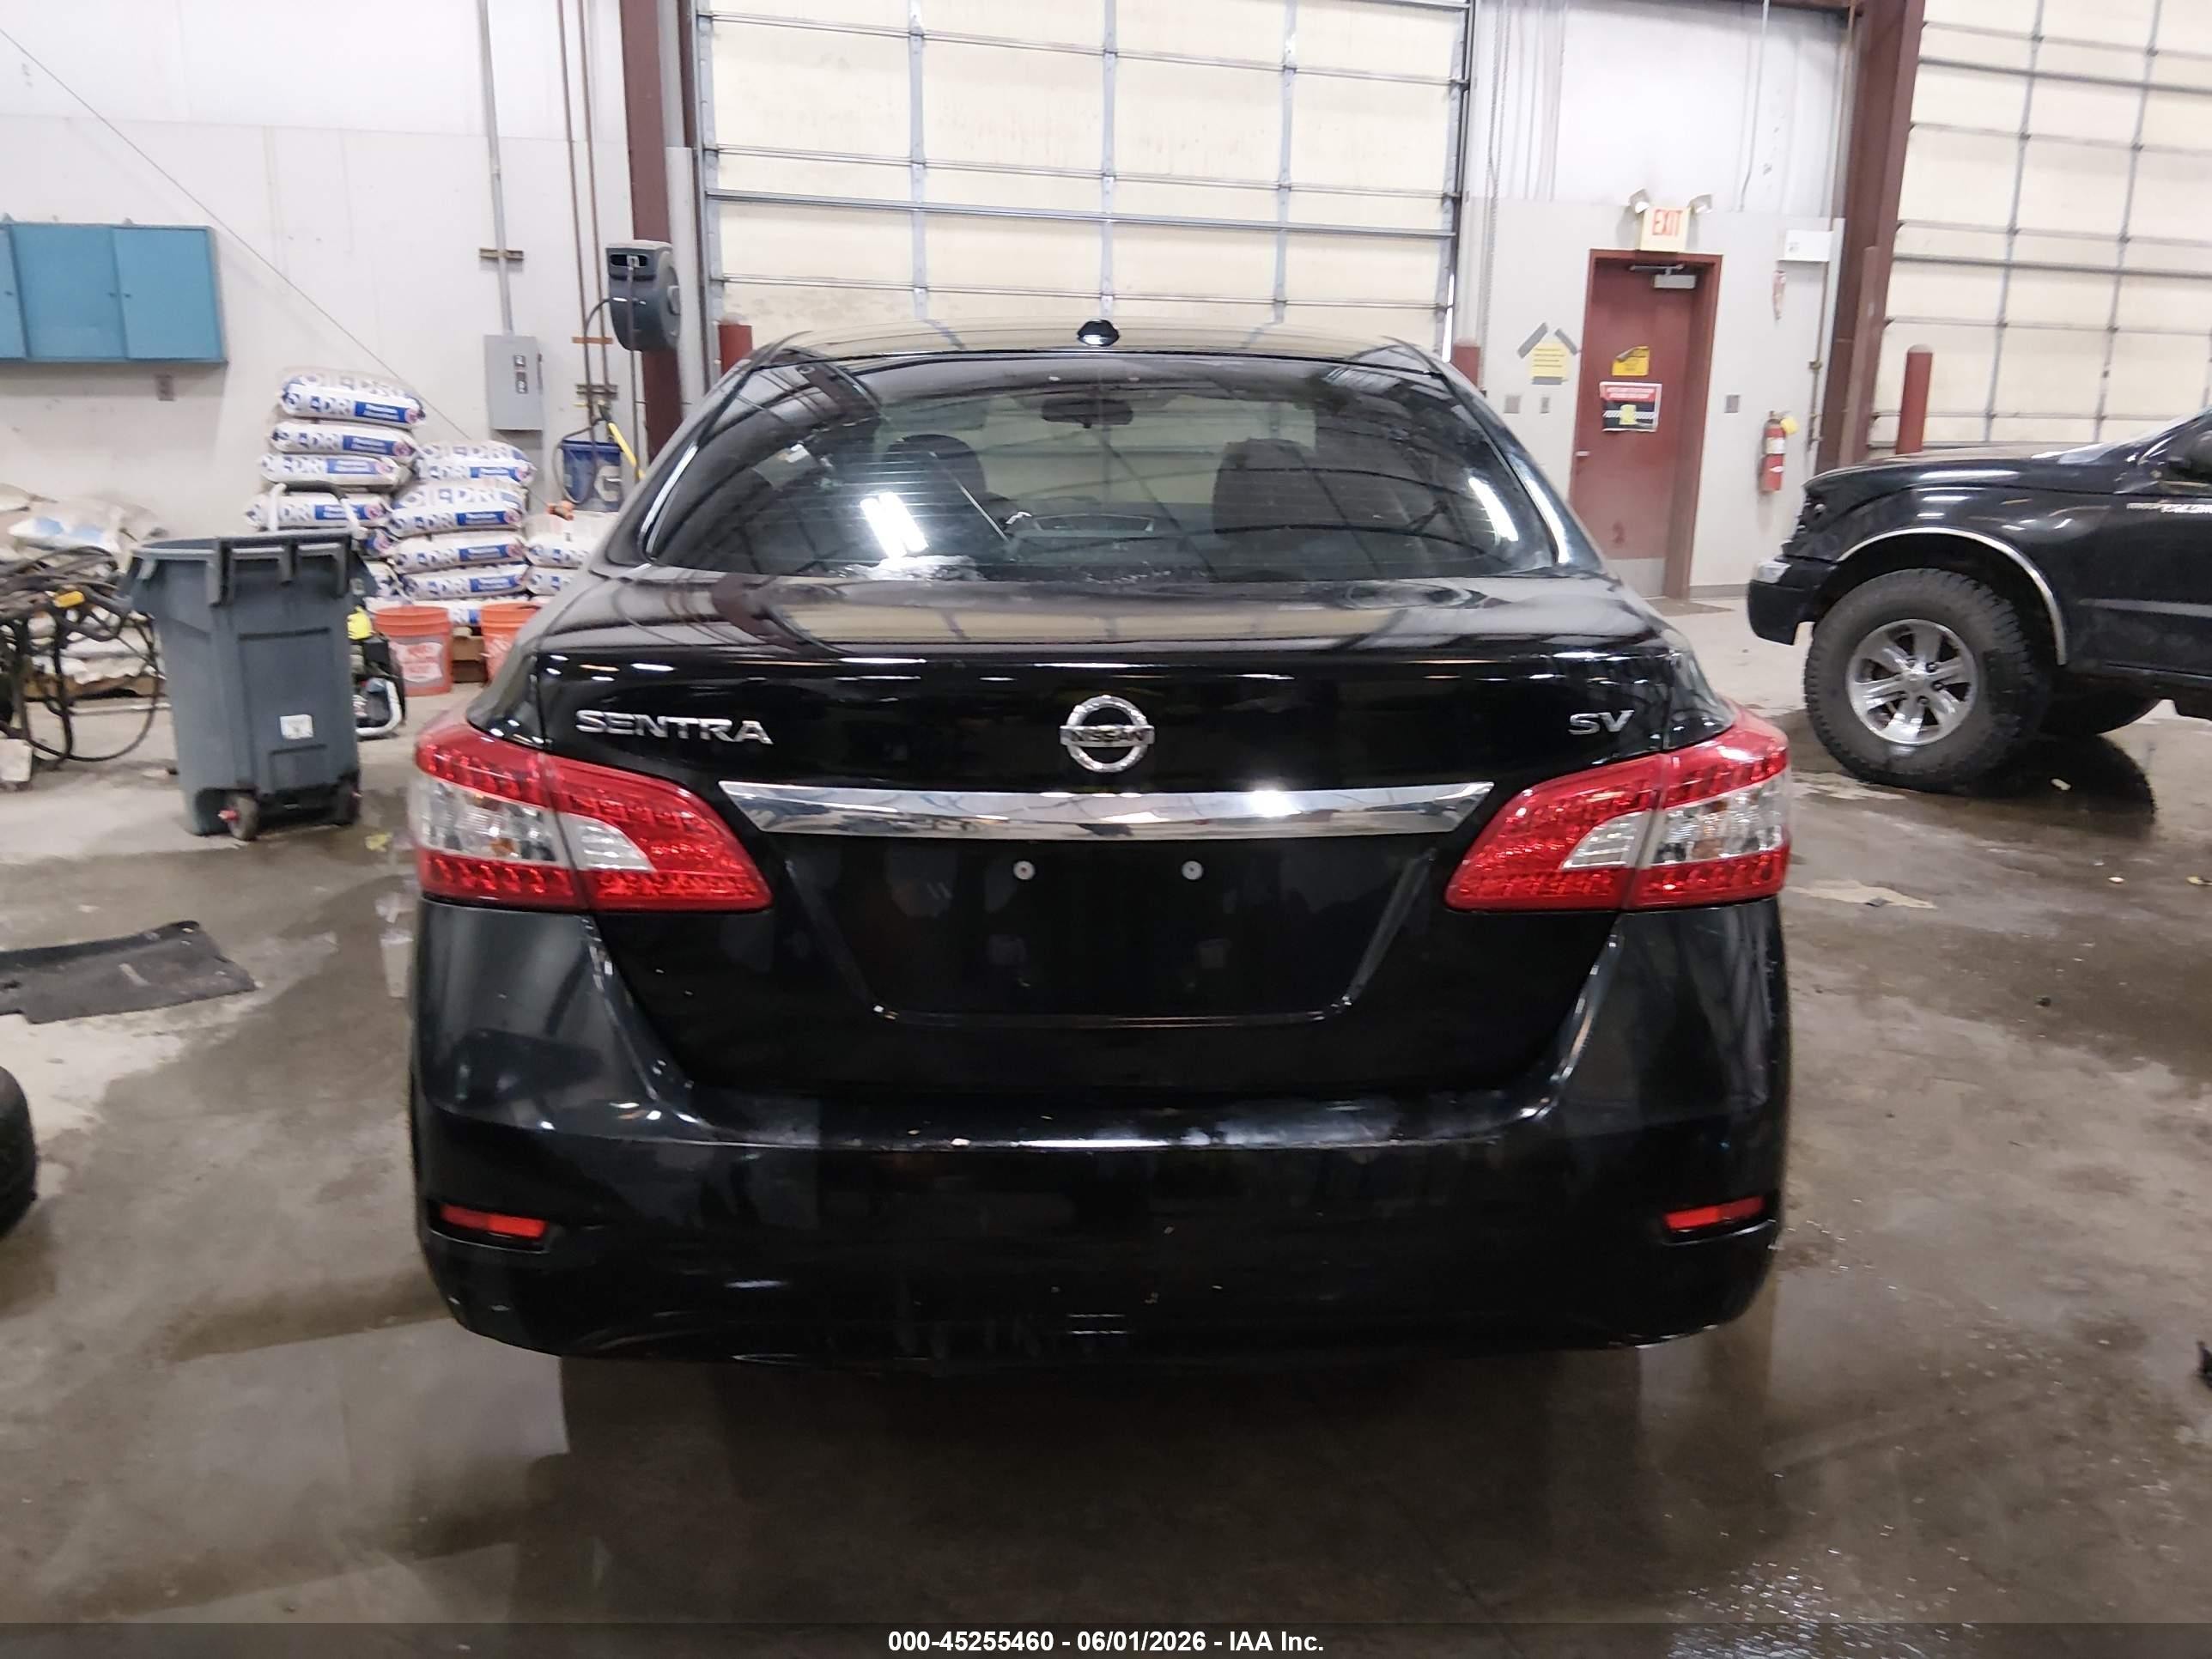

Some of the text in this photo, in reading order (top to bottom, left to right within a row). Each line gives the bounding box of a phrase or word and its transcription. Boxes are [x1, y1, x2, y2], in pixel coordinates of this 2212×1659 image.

[1651, 209, 1683, 237] EXIT
[576, 709, 774, 744] SENTRA
[1568, 709, 1635, 735] SV
[1070, 729, 1146, 743] NISSAN
